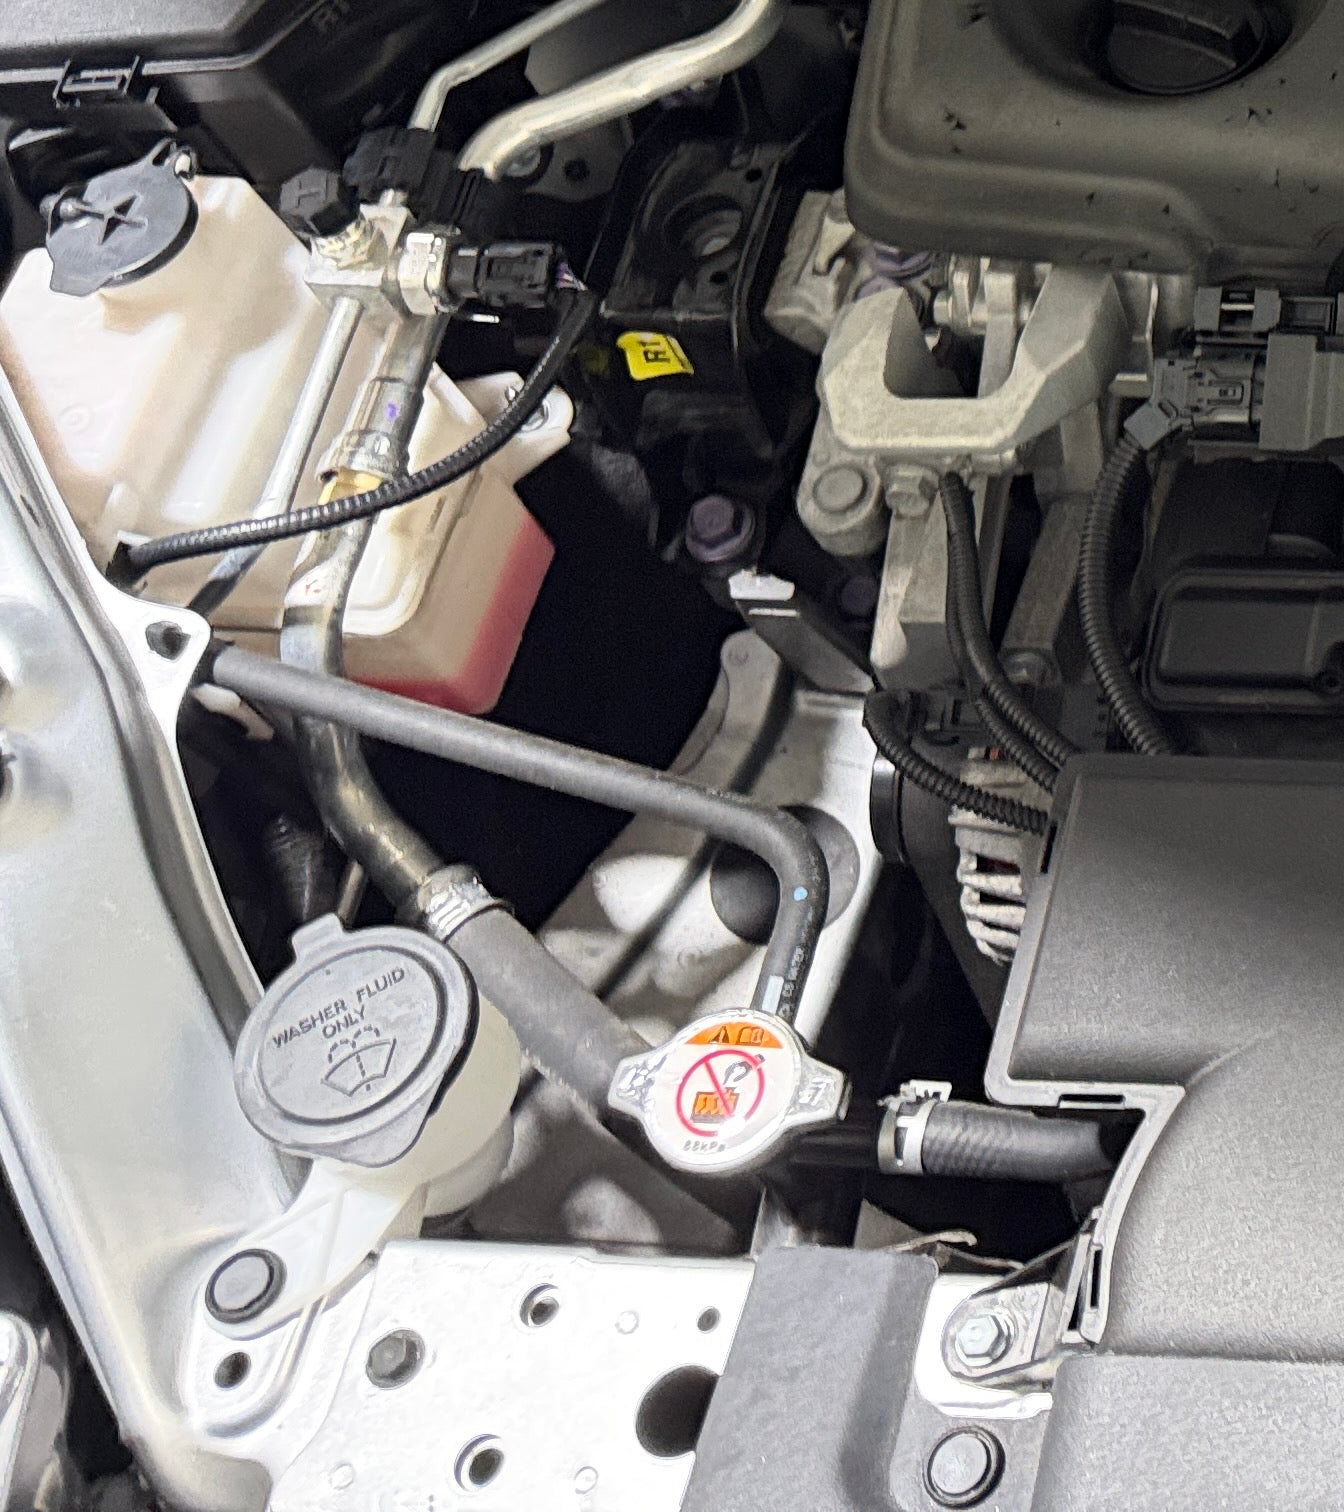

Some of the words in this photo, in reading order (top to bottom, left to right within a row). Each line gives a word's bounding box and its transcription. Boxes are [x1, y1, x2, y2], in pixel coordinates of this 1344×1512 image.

[273, 998, 348, 1048] WASHER
[356, 967, 405, 1003] FLUID
[322, 1004, 365, 1039] ONLY
